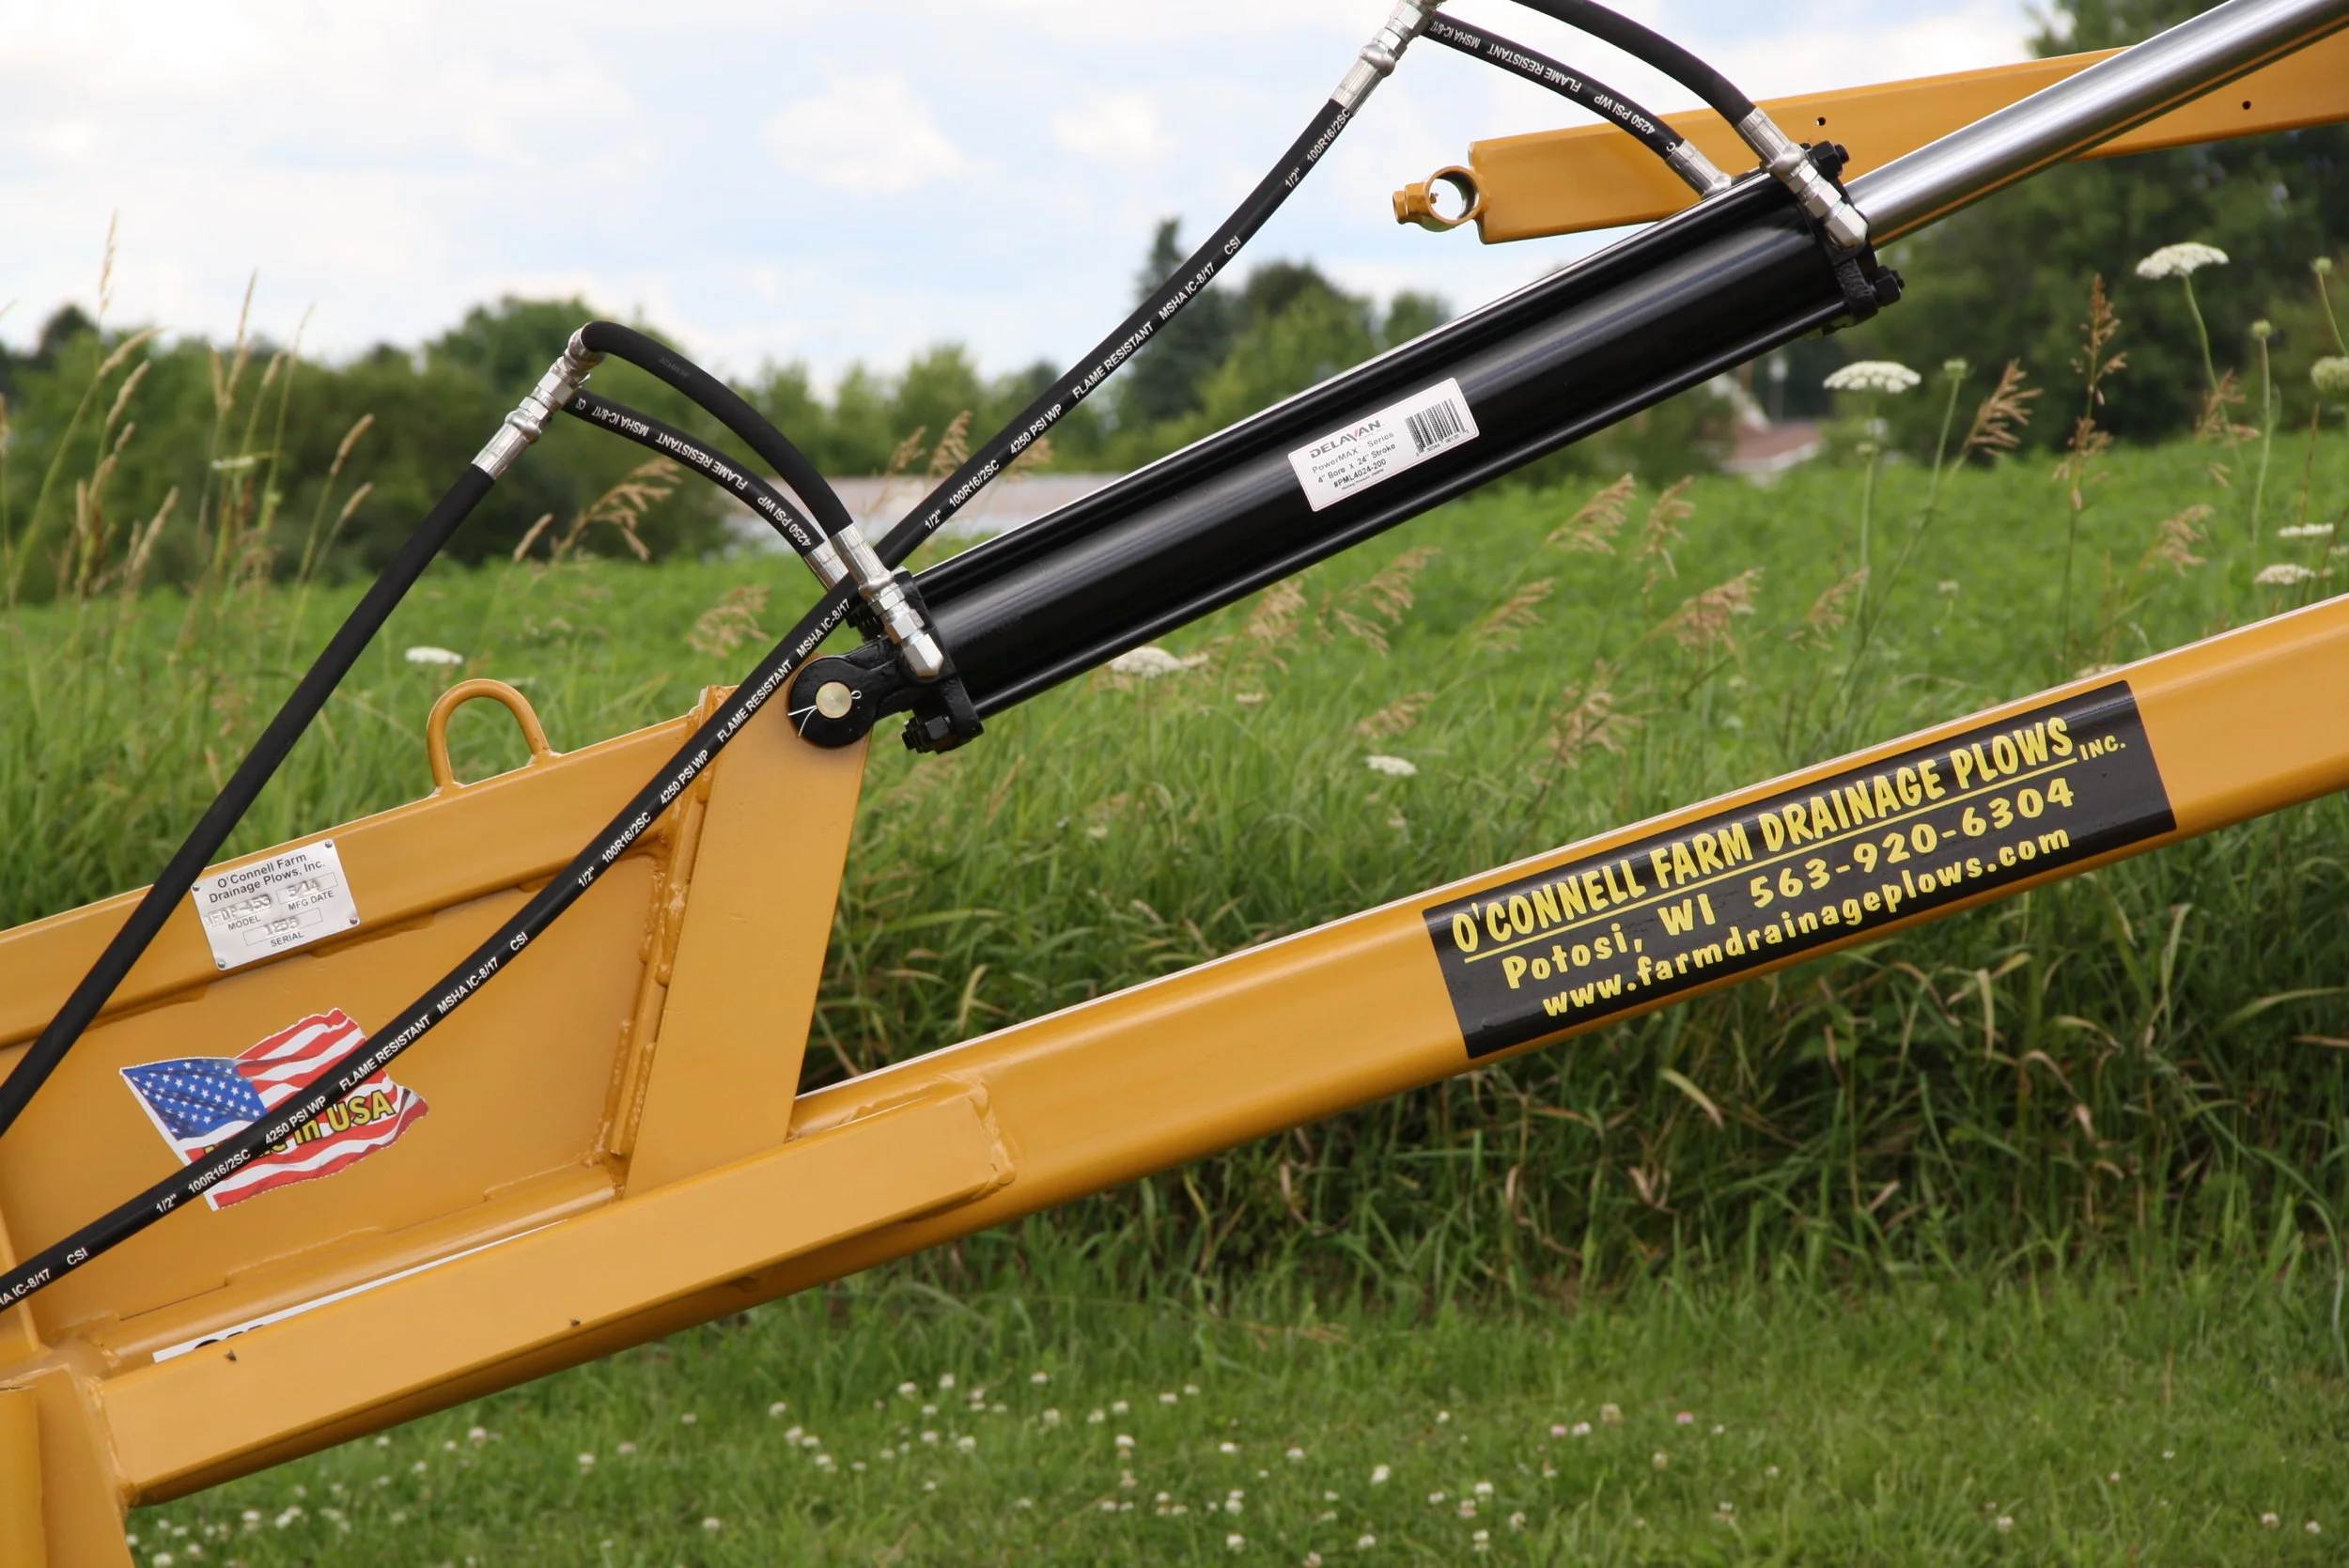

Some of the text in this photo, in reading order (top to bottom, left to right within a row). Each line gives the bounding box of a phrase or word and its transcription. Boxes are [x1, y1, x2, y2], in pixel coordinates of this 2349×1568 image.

[1454, 29, 1482, 49] MSHA
[1486, 43, 1545, 76] RESISTANT
[1543, 68, 1582, 93] FLAME
[1594, 93, 1613, 111] WP
[1612, 101, 1631, 121] PSI
[1630, 115, 1656, 135] 4250
[925, 107, 1351, 531] 1/2" 100R16/2SC 4250 PSI WP FLAME RESISTANT MSHA IC-8/17 CSI 1/2" 100R16/2SC
[591, 405, 621, 425] IC-8/17
[620, 415, 650, 437] MSHA
[655, 432, 714, 470] RESISTANT
[1309, 420, 1381, 458] DELAVAN
[1312, 447, 1359, 473] PowerMAX
[1367, 431, 1394, 448] Series
[712, 461, 749, 490] FLAME
[1329, 466, 1346, 479] Bore
[1371, 442, 1396, 458] Stroke
[756, 495, 775, 514] WP
[774, 509, 792, 528] PSI
[788, 522, 813, 548] 4250
[1452, 717, 2126, 953] O'CONNELL FARM DRAINAGE PLOWS INC.
[209, 861, 325, 904] Drainage Plows, Inc.
[217, 854, 307, 889] O'Connell Farm
[1502, 777, 2075, 989] Potosi, WI 563-920-6304
[227, 890, 334, 931] MODEL MFG DATE
[1543, 828, 2070, 1017] www.farmdrainageplows.com
[12, 1268, 51, 1296] IC-8/17
[67, 1247, 88, 1266] CSI
[156, 1194, 178, 1213] 1/2"
[189, 1149, 252, 1194] 100R16/2SC
[265, 1122, 290, 1144] 4250
[289, 1109, 310, 1129] PSI
[306, 1095, 327, 1116] WP
[339, 1058, 378, 1092] FLAME
[375, 1015, 431, 1062] RESISTANT
[436, 986, 469, 1015] MSHA
[465, 956, 499, 990] IC-8/17
[509, 931, 528, 952] CSI
[578, 866, 596, 887] 1/2"
[601, 812, 651, 864] 100R16/2SC
[660, 781, 680, 805] 4250
[678, 765, 695, 785] PSI
[692, 749, 708, 767] WP
[717, 709, 749, 743] FLAME
[745, 659, 792, 712] RESISTANT
[796, 629, 824, 659] MSHA
[821, 598, 850, 631] IC-8/17
[271, 931, 303, 947] SERIAL
[328, 1089, 397, 1133] USA
